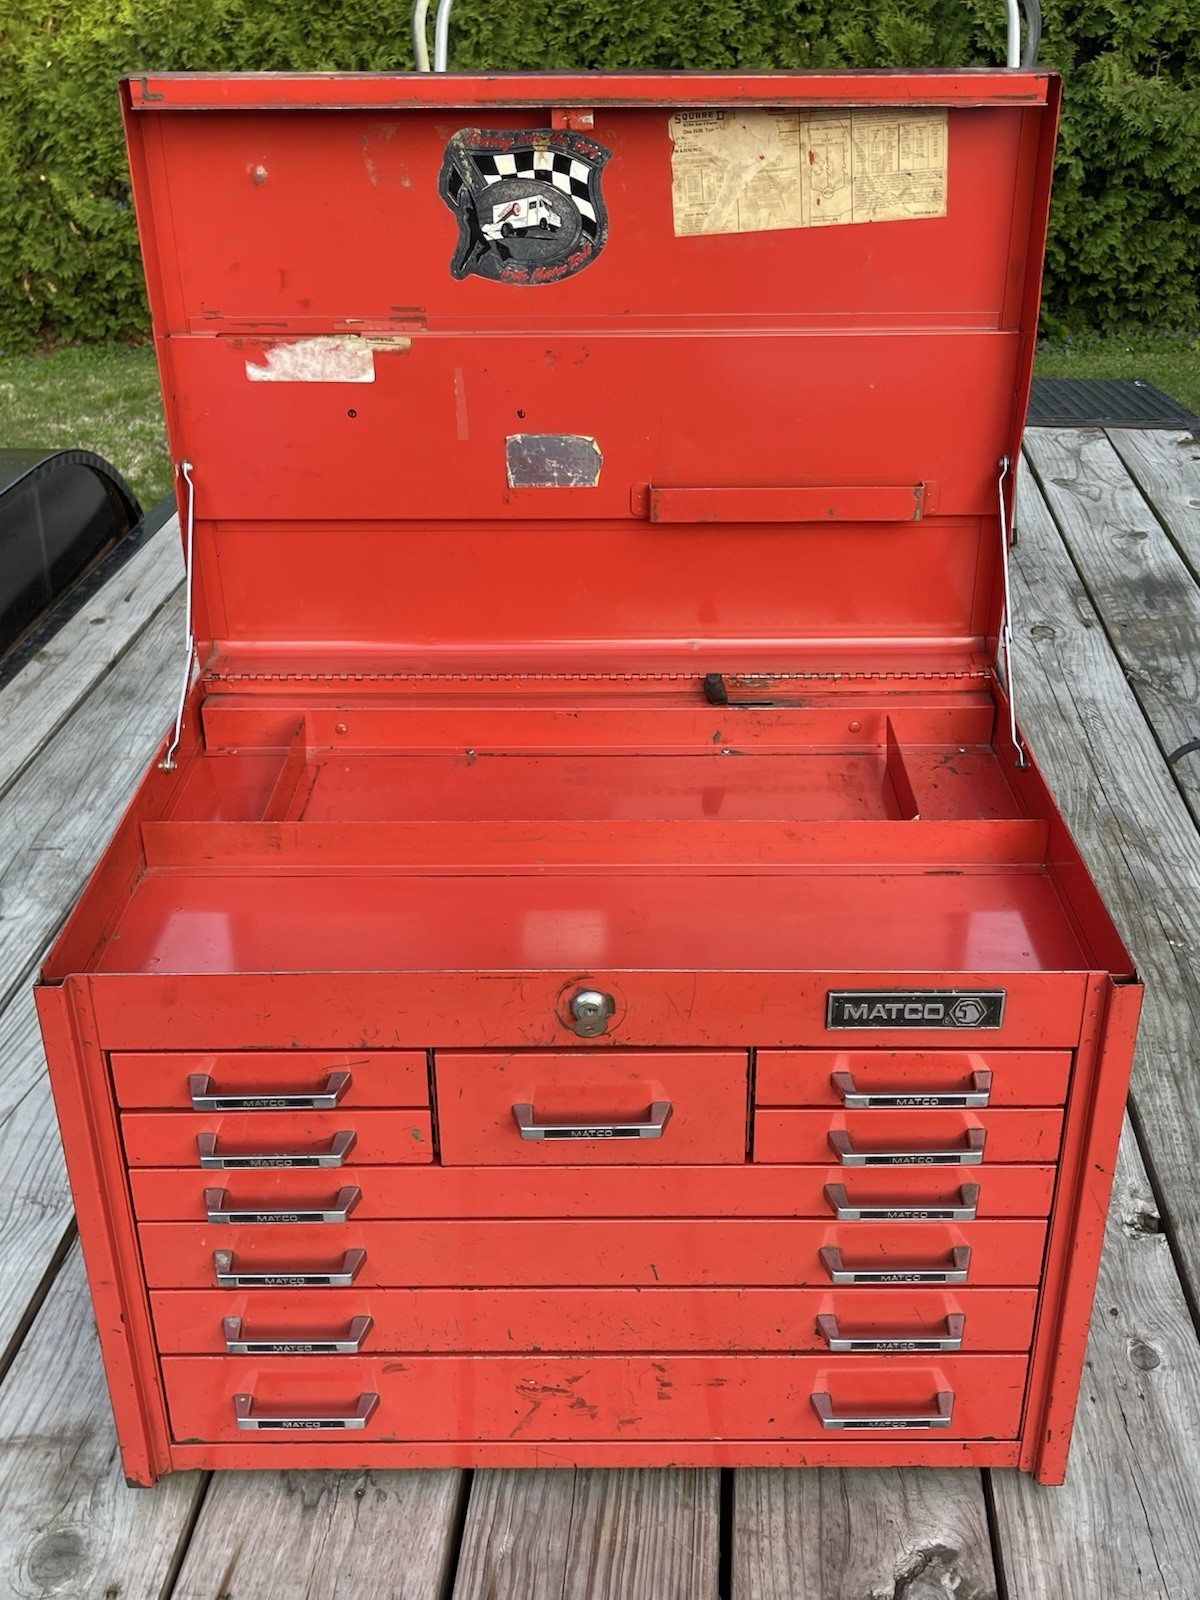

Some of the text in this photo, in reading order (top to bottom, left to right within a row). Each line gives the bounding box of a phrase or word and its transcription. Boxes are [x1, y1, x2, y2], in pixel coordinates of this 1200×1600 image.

[675, 111, 714, 124] SQUARE
[716, 110, 725, 121] D
[843, 1003, 945, 1020] MATCO
[243, 1099, 286, 1108] MATCO
[896, 1098, 938, 1106] MATCO
[250, 1159, 293, 1167] MATCO
[891, 1156, 934, 1164] MATCO
[256, 1214, 298, 1222] MATCO
[886, 1211, 928, 1219] MATCO
[265, 1277, 305, 1285] MATCO
[273, 1344, 312, 1352] MATCO
[282, 1421, 321, 1429] MATCO
